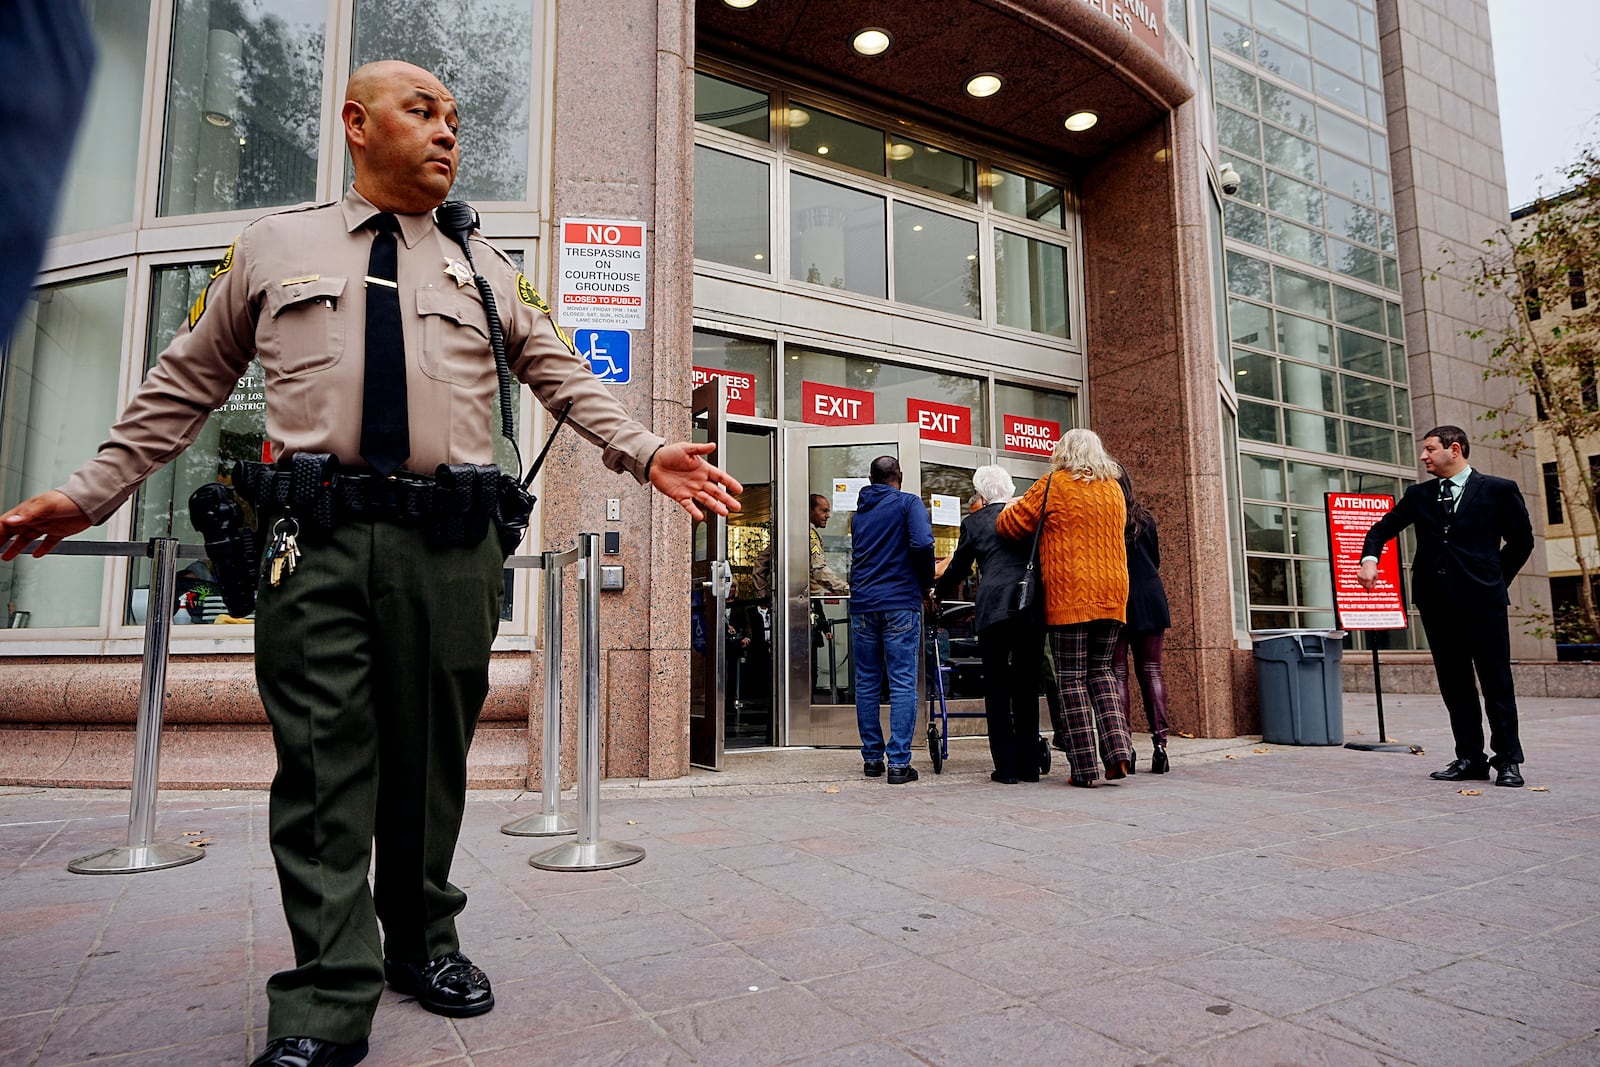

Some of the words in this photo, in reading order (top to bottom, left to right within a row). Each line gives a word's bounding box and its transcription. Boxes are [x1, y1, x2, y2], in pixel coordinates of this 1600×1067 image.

[587, 225, 621, 245] NO
[565, 247, 641, 259] TRESPASSING
[595, 260, 611, 269] ON
[564, 270, 641, 281] COURTHOUSE
[575, 282, 630, 293] GROUNDS
[564, 295, 597, 303] CLOSED
[238, 376, 257, 388] ST.
[235, 393, 246, 401] OF
[248, 392, 263, 400] LOS
[230, 402, 266, 411] DISTRICT
[815, 394, 862, 420] EXIT
[918, 410, 960, 434] EXIT
[1013, 422, 1051, 439] PUBLIC
[1334, 496, 1389, 510] ATTENTION
